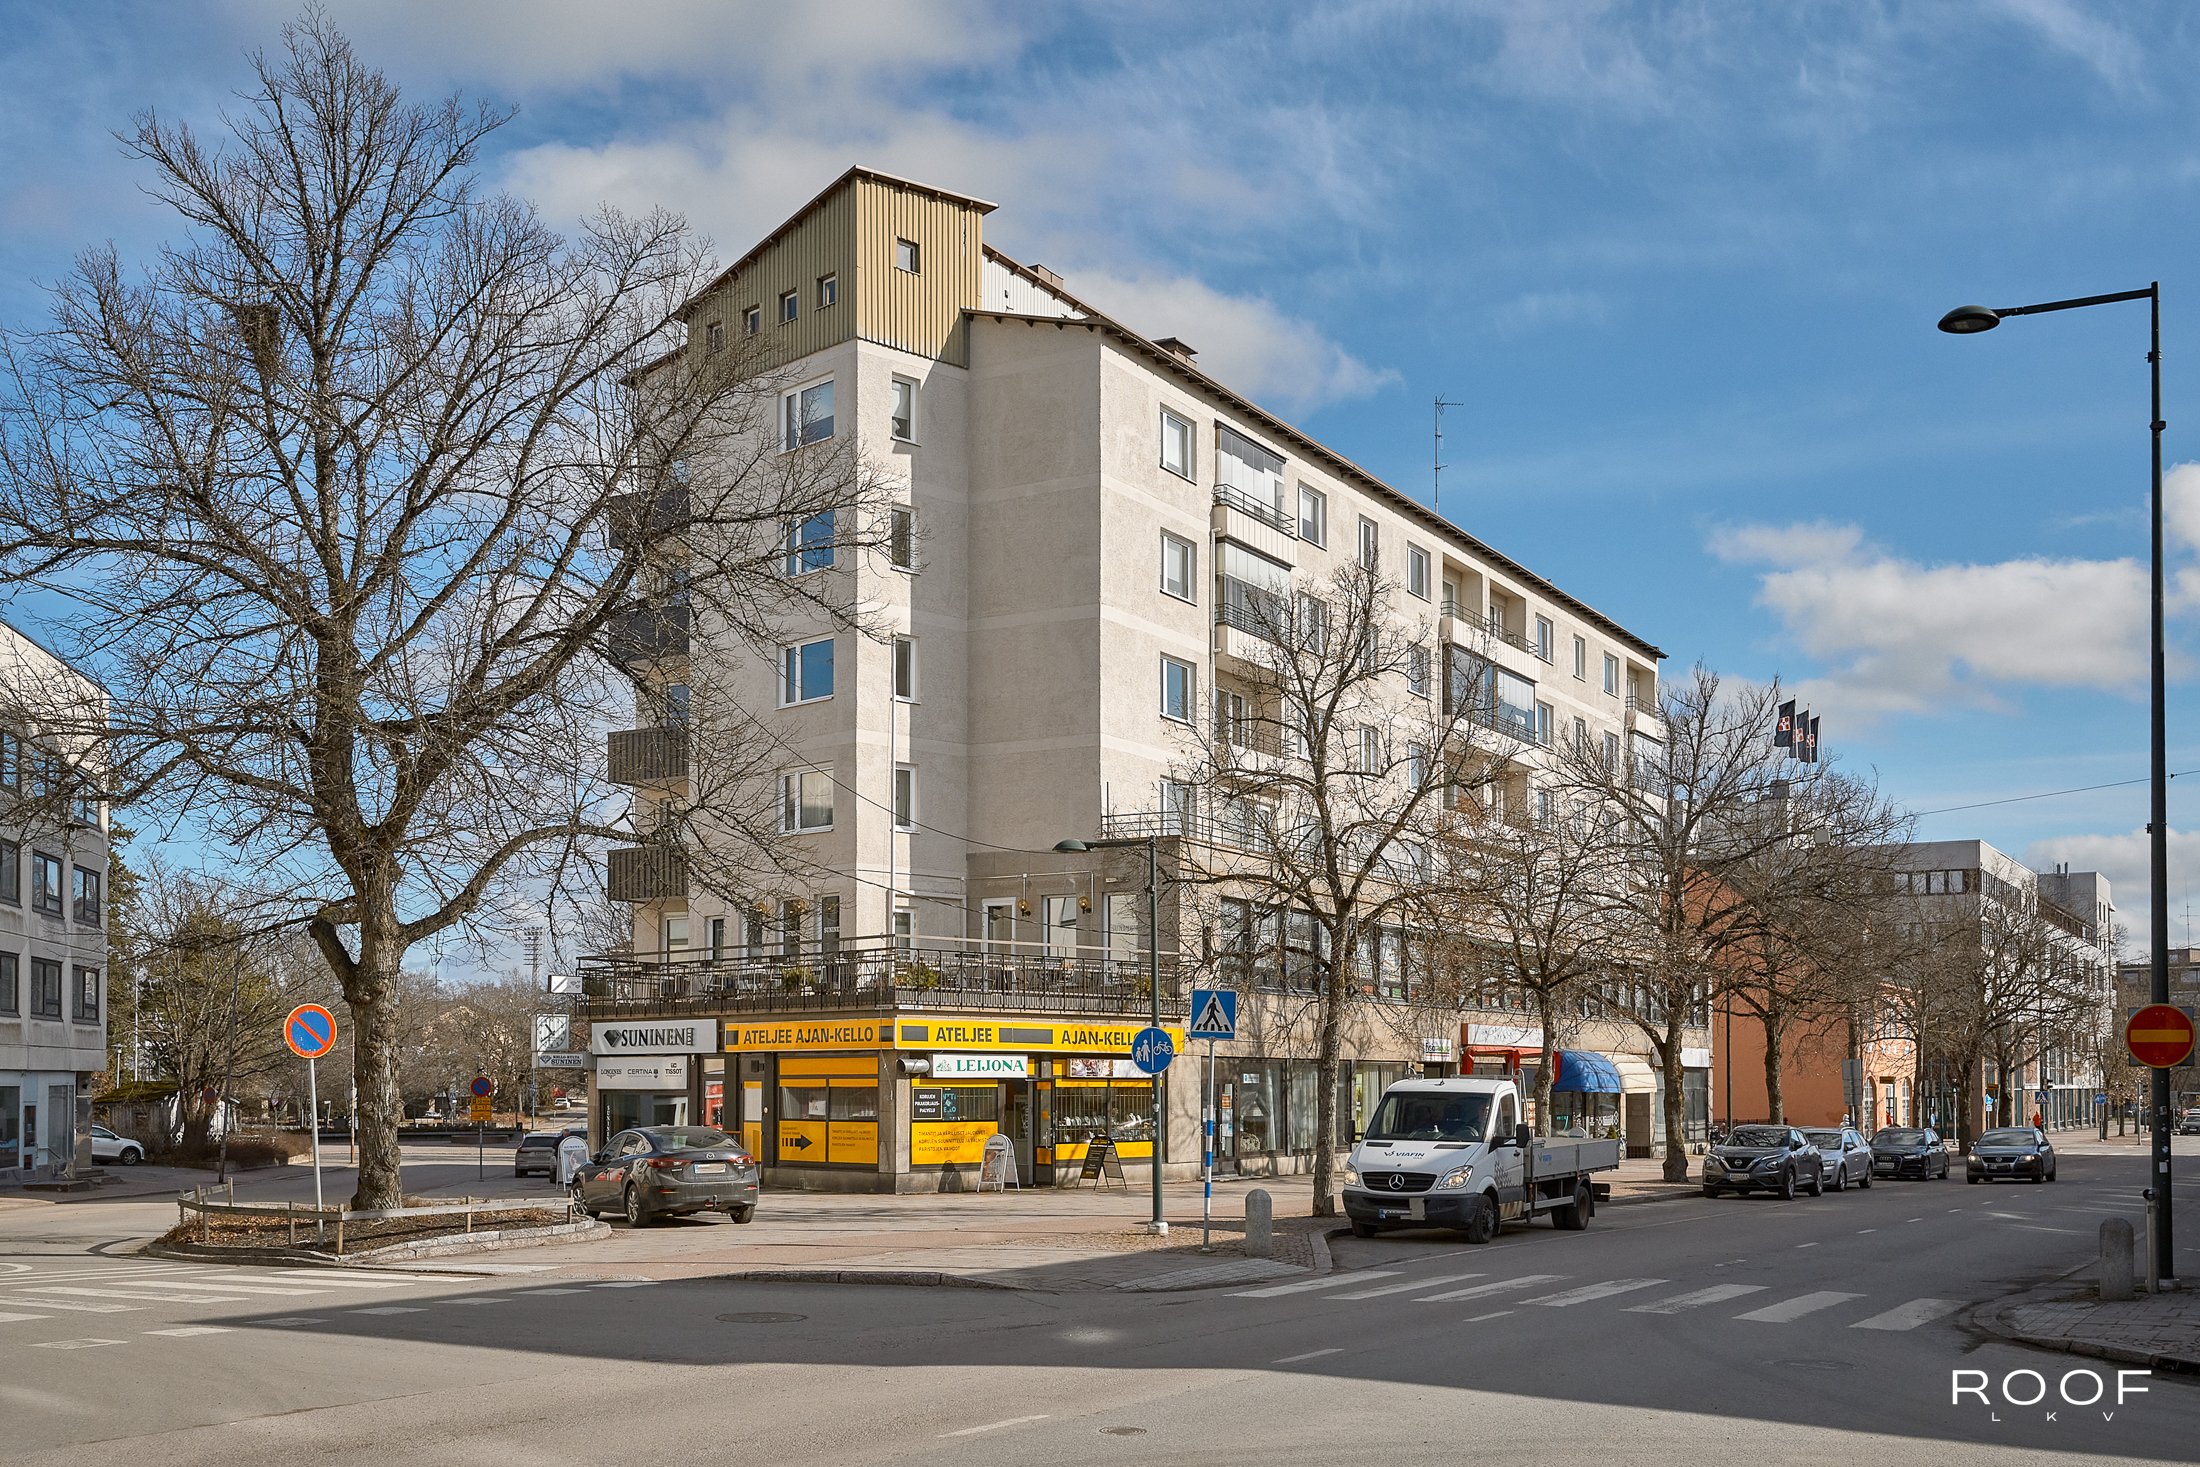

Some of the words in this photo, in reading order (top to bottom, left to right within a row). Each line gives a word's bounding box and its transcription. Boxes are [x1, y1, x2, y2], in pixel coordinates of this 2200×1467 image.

[621, 1028, 685, 1047] SUNINEN
[743, 1029, 792, 1044] ATELJEE
[795, 1026, 874, 1044] AJAN-KELLO
[935, 1027, 992, 1043] ATELJEE
[1061, 1030, 1138, 1046] AJAN-KELL
[956, 1060, 1025, 1072] LEIJONA
